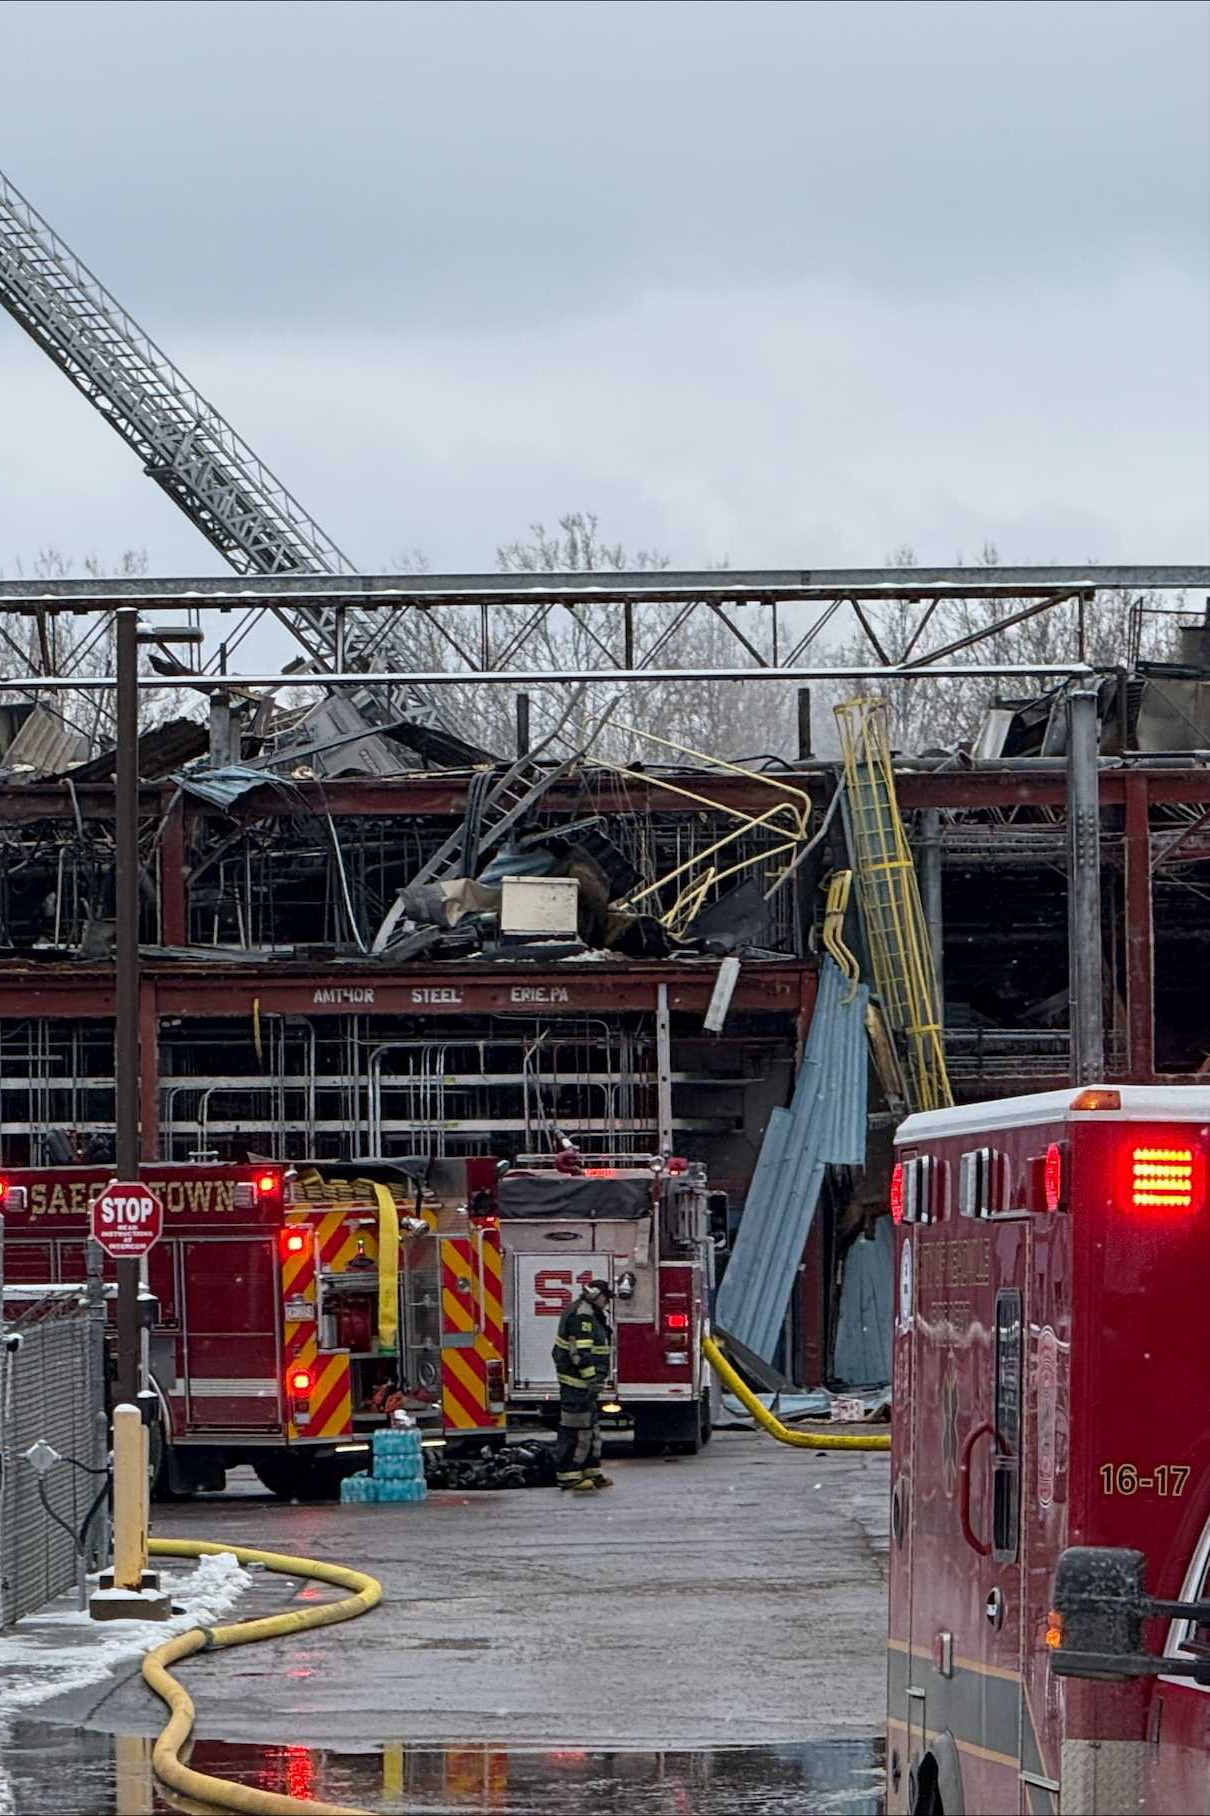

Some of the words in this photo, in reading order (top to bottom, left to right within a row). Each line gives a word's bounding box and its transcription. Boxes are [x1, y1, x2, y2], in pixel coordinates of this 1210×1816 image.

[411, 988, 463, 1003] STEEL
[30, 1181, 236, 1215] SAETOWN
[101, 1196, 154, 1224] STOP
[1100, 1463, 1191, 1497] 16-17
